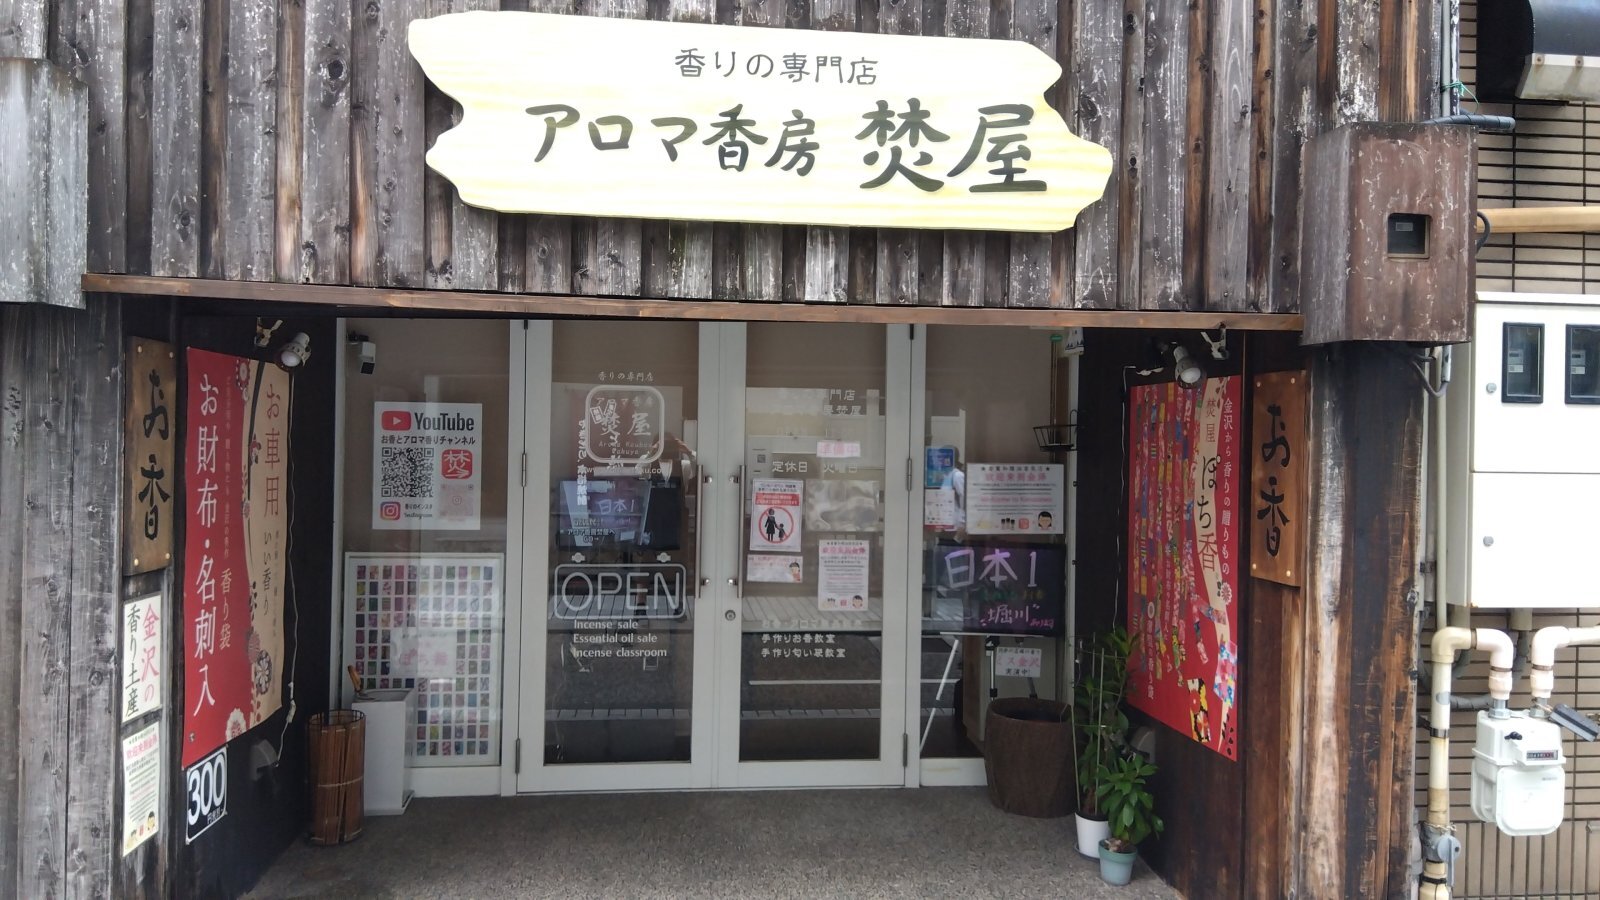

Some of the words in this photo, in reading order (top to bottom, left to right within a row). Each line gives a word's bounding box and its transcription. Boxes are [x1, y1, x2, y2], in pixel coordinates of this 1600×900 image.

[675, 48, 878, 87] 香りの専門店
[525, 103, 821, 176] アロマ香房
[855, 98, 1048, 193] 焚屋
[598, 371, 654, 382] 香りの専門店
[381, 434, 475, 446] お香とアロマ香りチャンネル
[414, 412, 474, 431] YouTube
[601, 412, 652, 436] 焚屋
[264, 383, 281, 516] お車用
[772, 461, 808, 473] 定休日
[1221, 398, 1233, 575] 金沢から香りの贈りもの
[193, 374, 219, 718] お財布・名刺入
[219, 568, 232, 650] 香り袋
[562, 572, 680, 611] OPEN
[573, 633, 618, 643] Essential
[621, 633, 634, 643] oil
[637, 633, 658, 643] sale
[574, 619, 613, 629] Incense
[618, 619, 639, 629] sale
[761, 634, 836, 644] 手作りお香教室
[125, 605, 141, 718] 香り土産
[142, 603, 160, 703] 金沢の
[573, 648, 613, 658] Incense
[616, 648, 667, 658] classroom
[188, 753, 226, 827] 300
